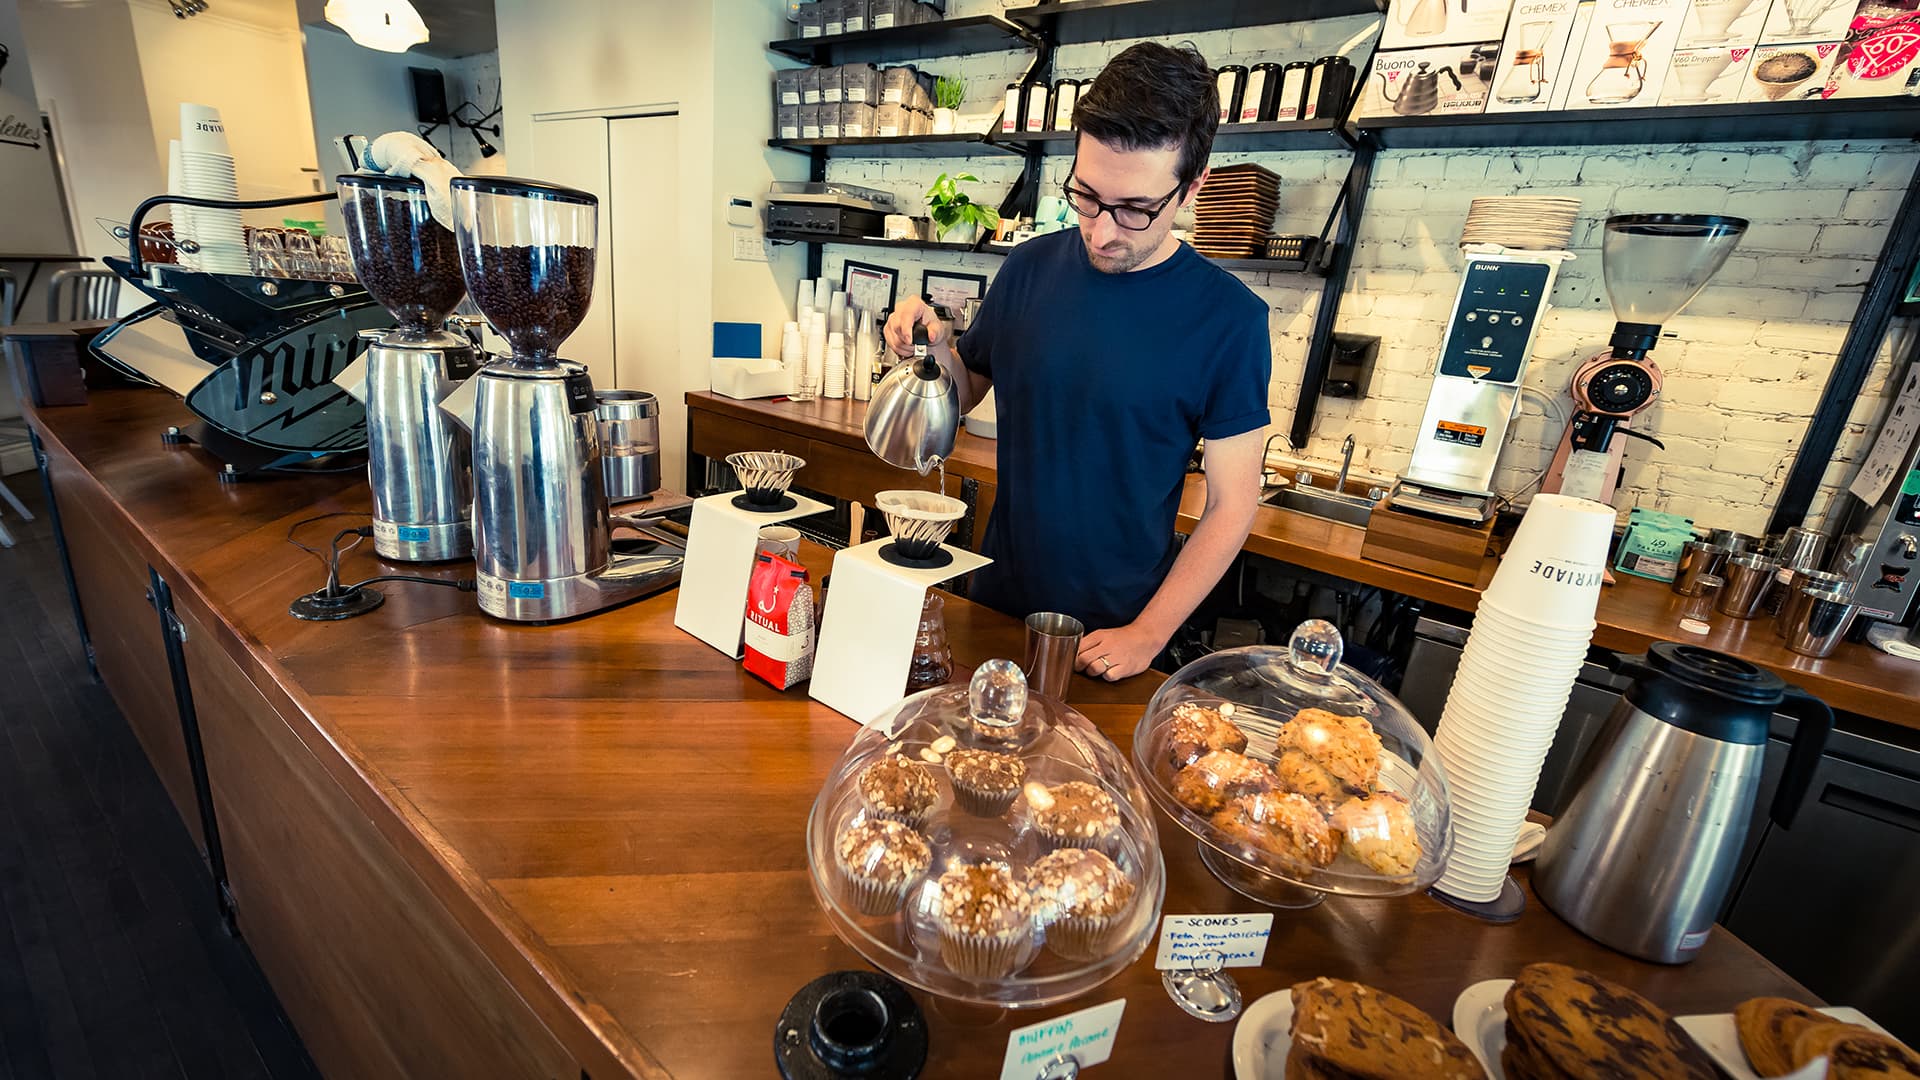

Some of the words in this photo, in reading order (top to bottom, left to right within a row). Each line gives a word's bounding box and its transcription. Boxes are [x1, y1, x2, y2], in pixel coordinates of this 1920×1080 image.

[1520, 3, 1567, 15] CHEMEX
[1376, 59, 1416, 71] Buono
[1674, 56, 1689, 64] V60
[0, 114, 40, 140] lettes
[750, 610, 780, 633] RITUAL
[1188, 917, 1239, 927] SCONES
